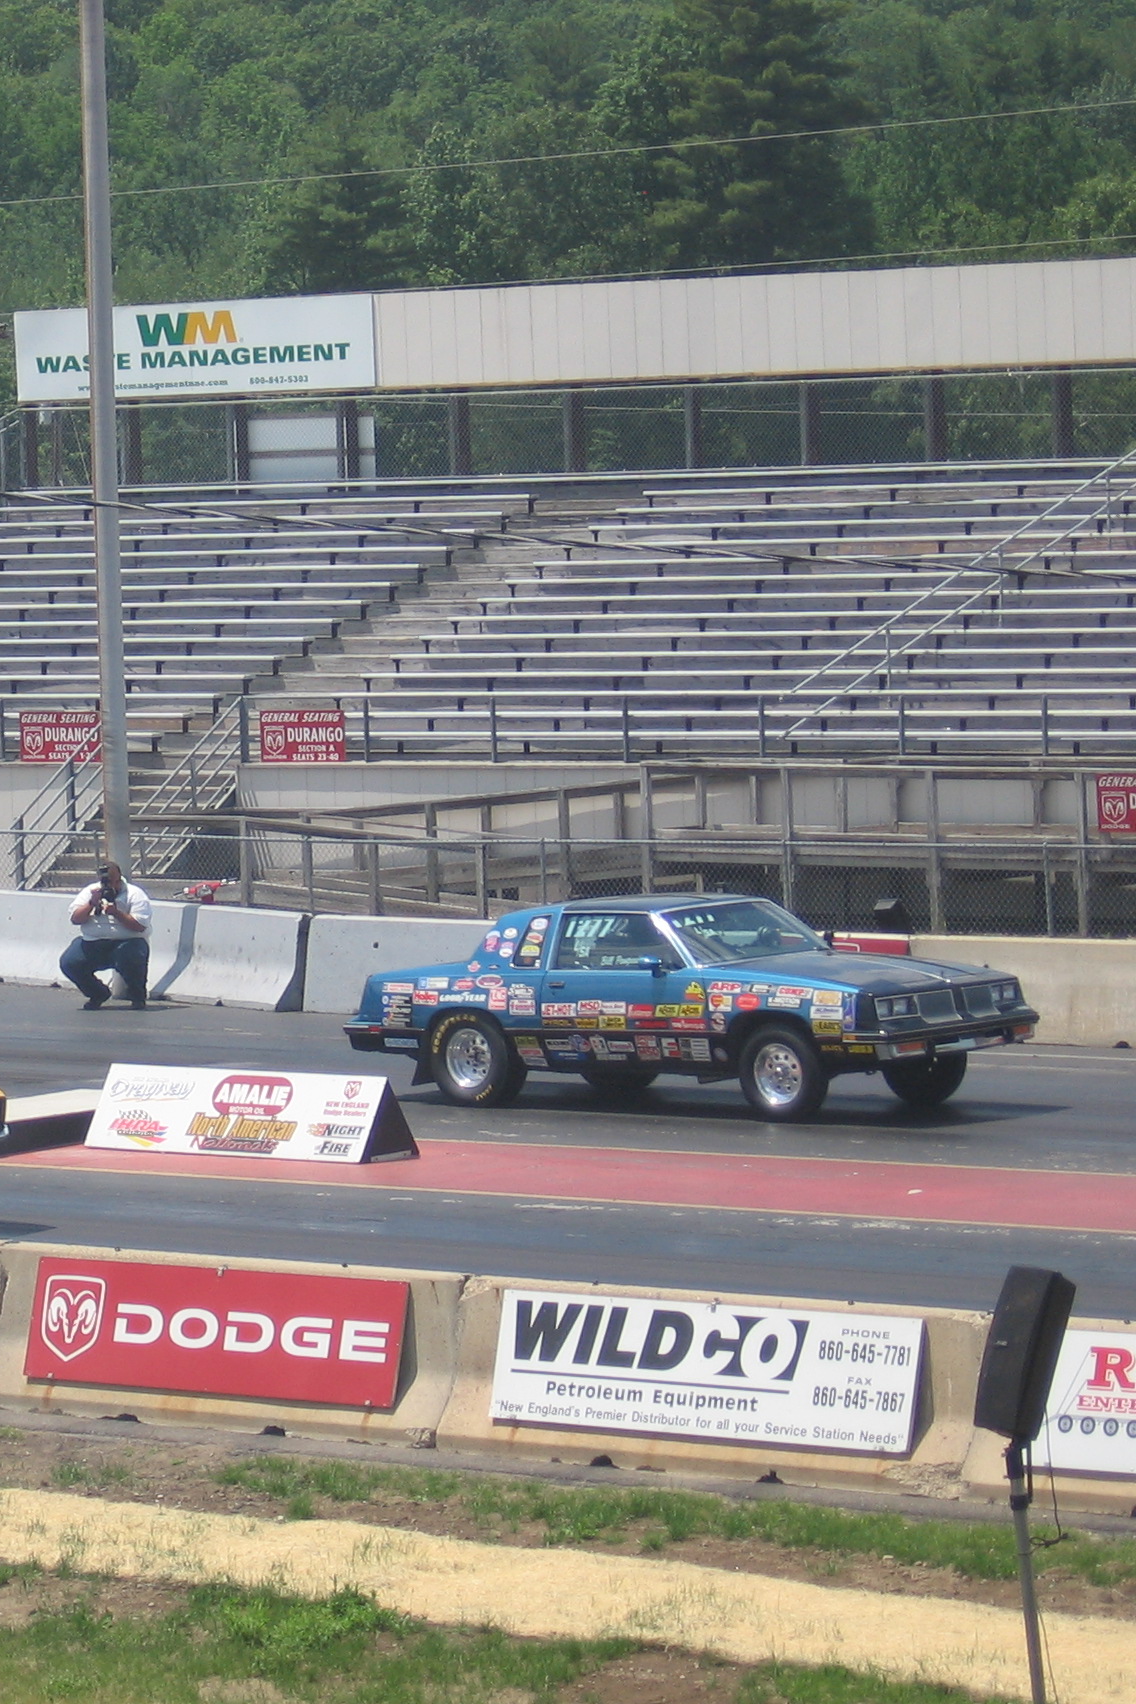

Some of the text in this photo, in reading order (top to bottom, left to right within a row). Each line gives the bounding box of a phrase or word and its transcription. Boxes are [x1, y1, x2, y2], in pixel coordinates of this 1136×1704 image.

[136, 310, 237, 347] WM
[36, 343, 350, 374] WAE MANAGEMENT
[21, 713, 96, 724] GENERAL SEATING
[261, 712, 340, 723] GENERAL SEATING
[45, 727, 98, 742] DURANGO
[287, 727, 343, 742] DURANGO
[292, 753, 315, 761] SEATS
[215, 1083, 291, 1106] AMALIE
[185, 1112, 298, 1141] North American
[112, 1302, 390, 1363] DODGE
[513, 1299, 810, 1381] WILDCO
[841, 1328, 890, 1340] PHONE
[818, 1339, 912, 1367] 860-645-7781
[847, 1376, 872, 1386] FAX
[545, 1380, 758, 1412] Petroleum Equipment
[812, 1385, 905, 1413] 860-645-7867
[527, 1402, 581, 1418] England's
[584, 1409, 628, 1422] Premier
[631, 1411, 691, 1427] Distributor
[695, 1416, 712, 1430] for
[716, 1418, 730, 1430] all
[734, 1422, 760, 1434] your
[764, 1422, 807, 1438] Service
[812, 1426, 855, 1441] Station
